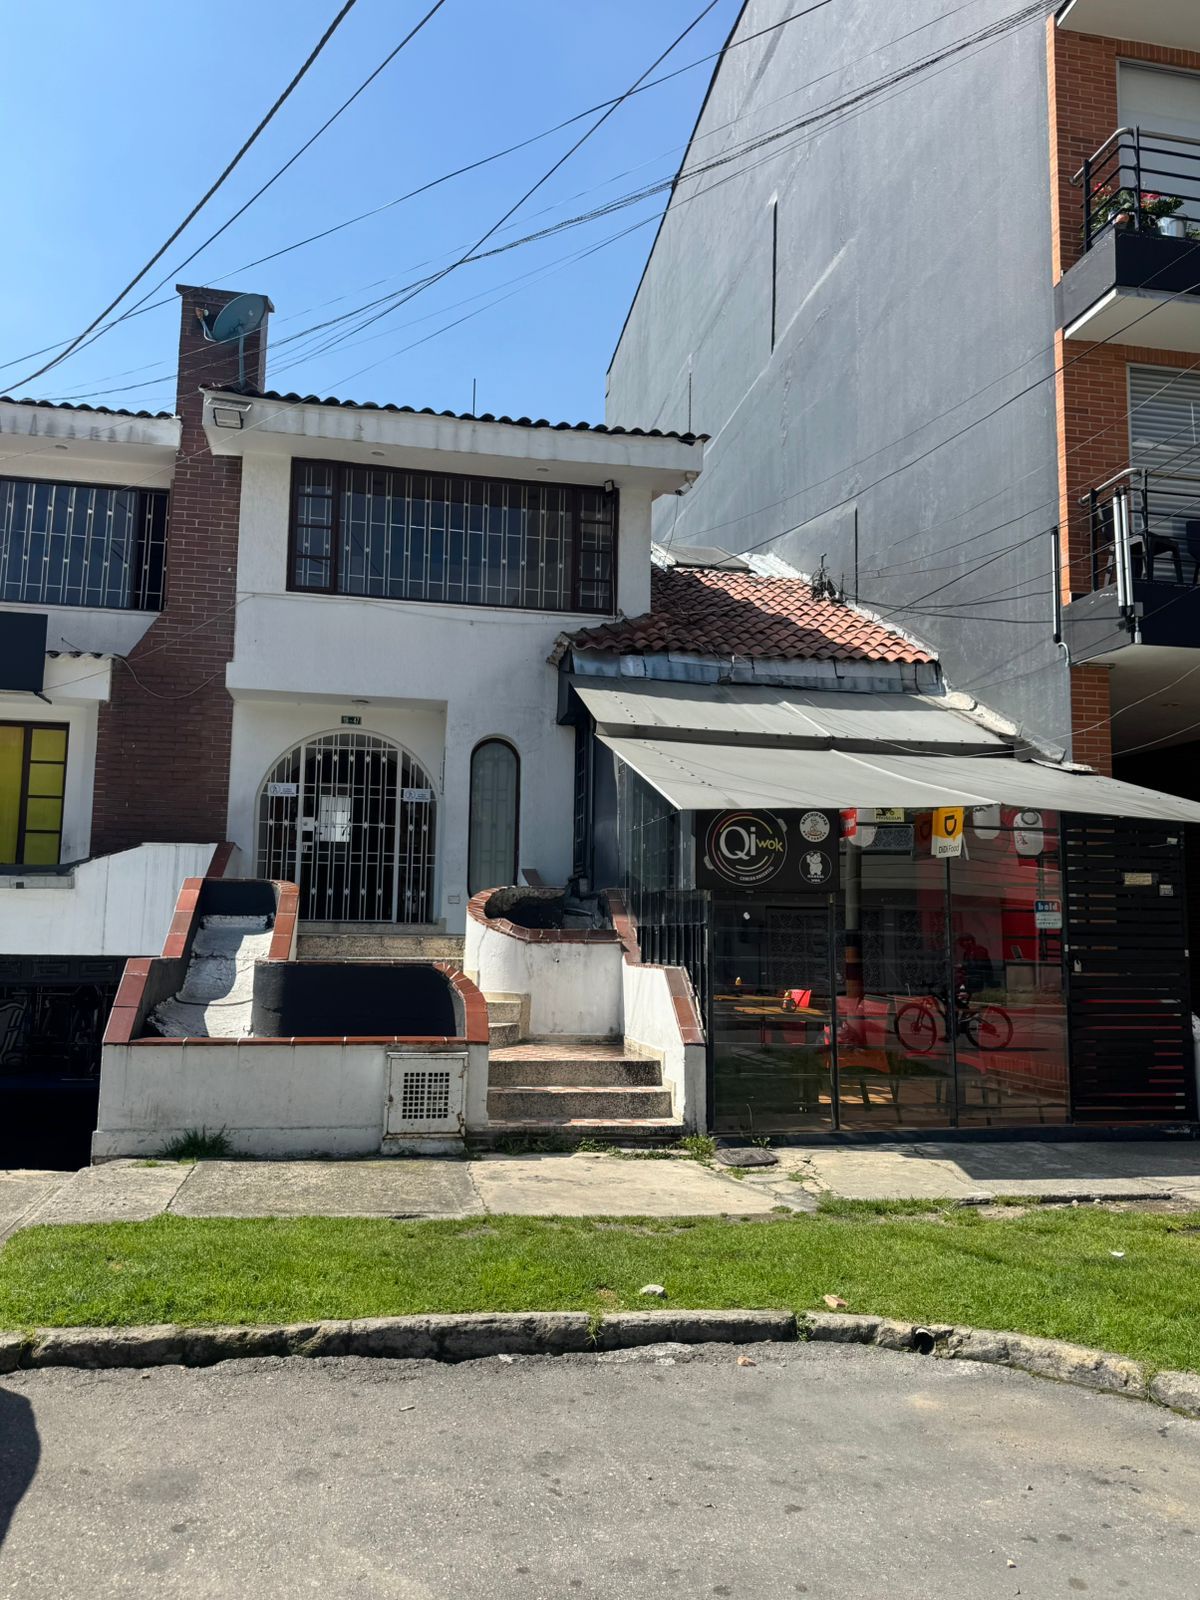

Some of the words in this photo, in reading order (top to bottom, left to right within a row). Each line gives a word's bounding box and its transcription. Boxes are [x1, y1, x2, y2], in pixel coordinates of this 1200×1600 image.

[720, 826, 756, 860] Qi
[756, 837, 784, 852] wok
[1037, 901, 1058, 911] bold
